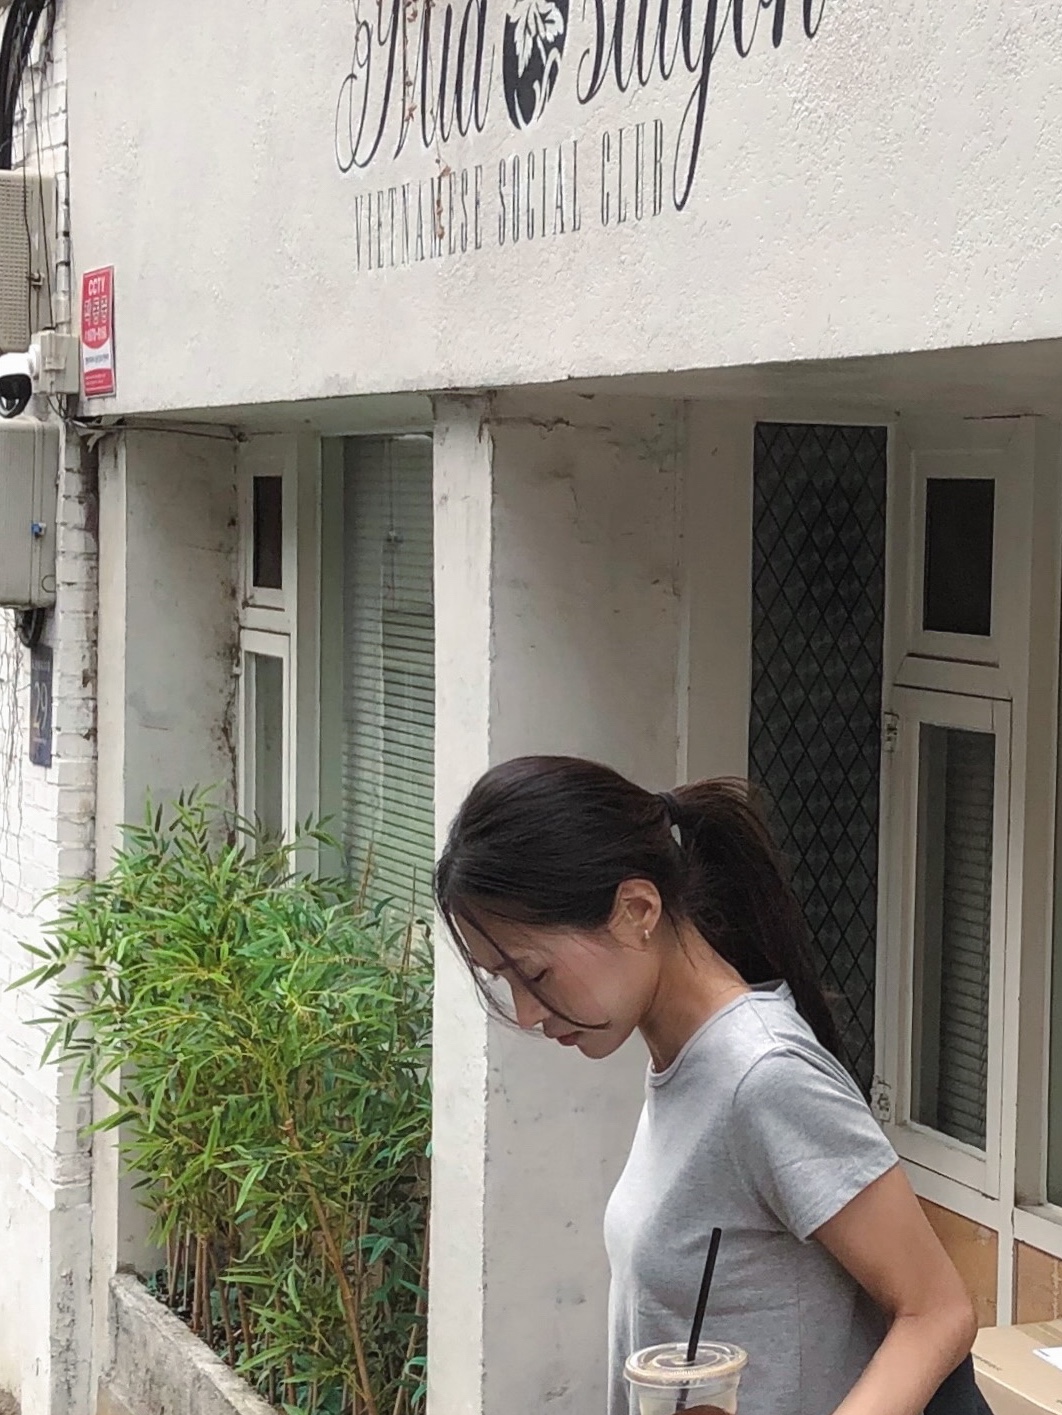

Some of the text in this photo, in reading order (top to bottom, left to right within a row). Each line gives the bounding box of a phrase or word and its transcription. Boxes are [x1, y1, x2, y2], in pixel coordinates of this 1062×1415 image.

[354, 118, 664, 271] VIETNAMESE SOCIAL CLUB
[88, 276, 106, 297] CCTV
